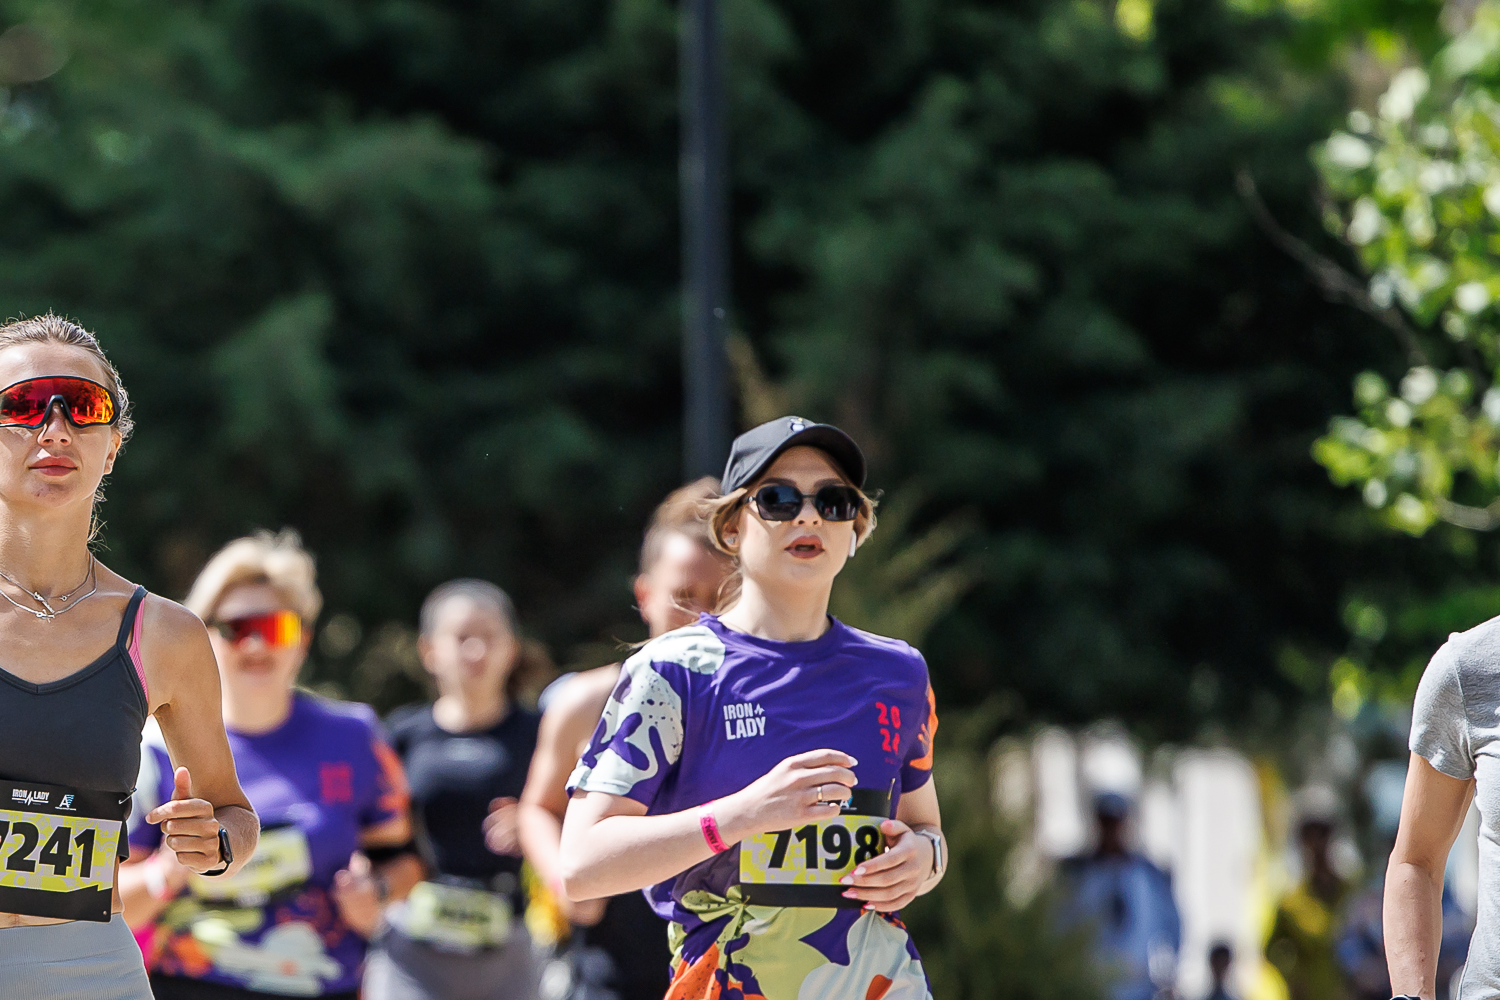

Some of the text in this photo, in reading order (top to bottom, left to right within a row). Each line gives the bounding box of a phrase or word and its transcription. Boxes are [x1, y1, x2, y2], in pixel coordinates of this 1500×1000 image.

[723, 702, 754, 720] IRON
[875, 702, 901, 729] 20
[725, 716, 766, 740] LADY
[12, 788, 50, 800] IRON LADY
[764, 824, 879, 870] 7198
